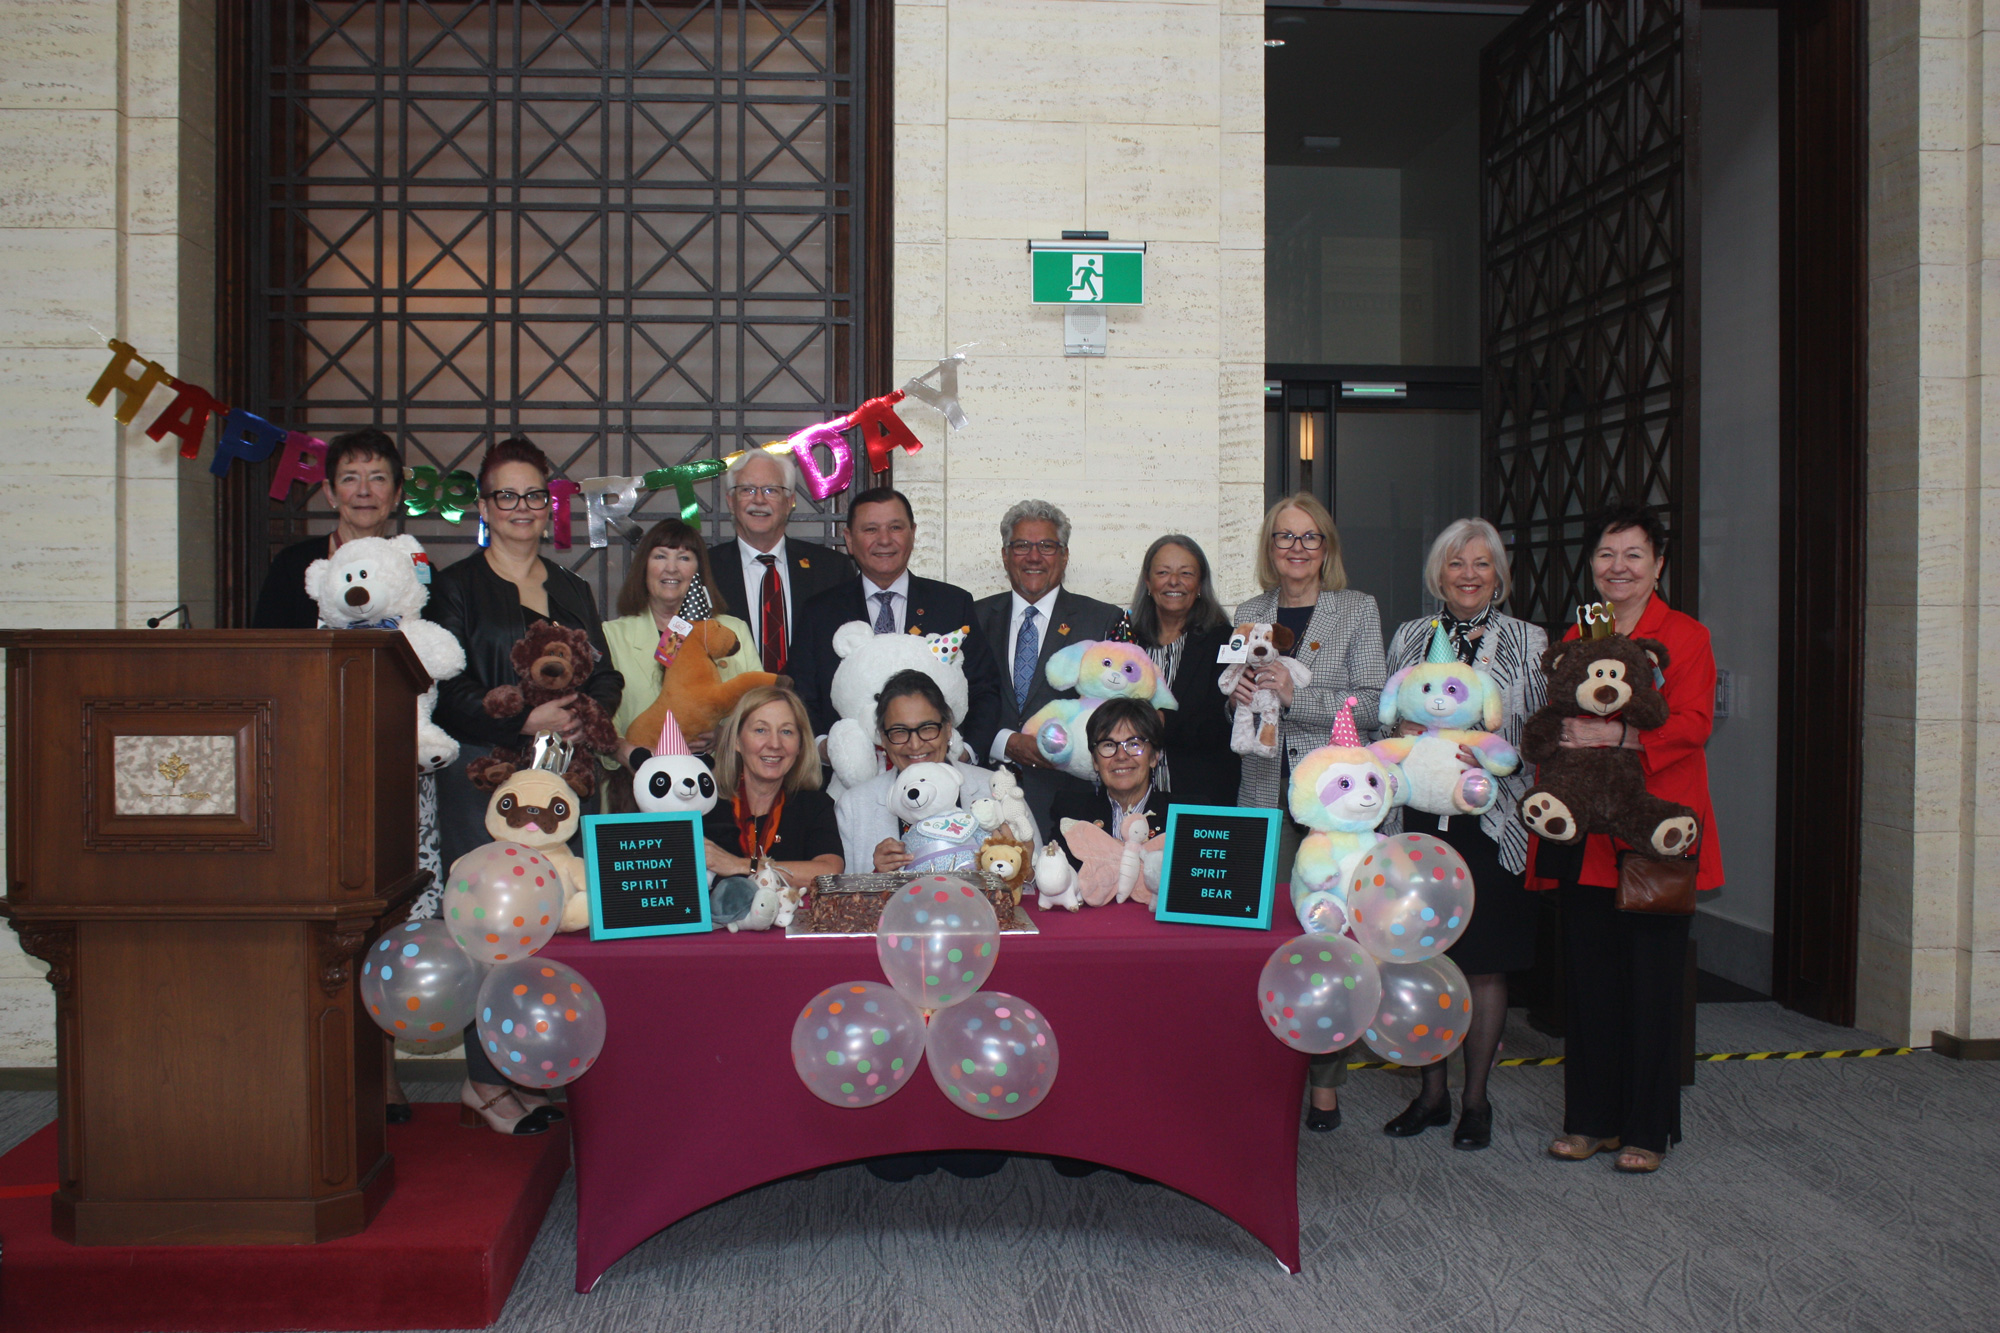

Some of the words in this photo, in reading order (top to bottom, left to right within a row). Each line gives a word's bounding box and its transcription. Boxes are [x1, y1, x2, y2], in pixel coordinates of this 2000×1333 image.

[86, 338, 329, 502] HAPP
[477, 352, 970, 550] IRTDAY
[1193, 829, 1230, 840] BONNE
[619, 839, 663, 850] HAPPY
[1200, 848, 1227, 860] FETE
[614, 858, 673, 871] BIRTHDAY
[1190, 867, 1227, 879] SPIRIT
[621, 879, 668, 891] SPIRIT
[1200, 888, 1232, 899] BEAR
[641, 896, 674, 908] BEAR
